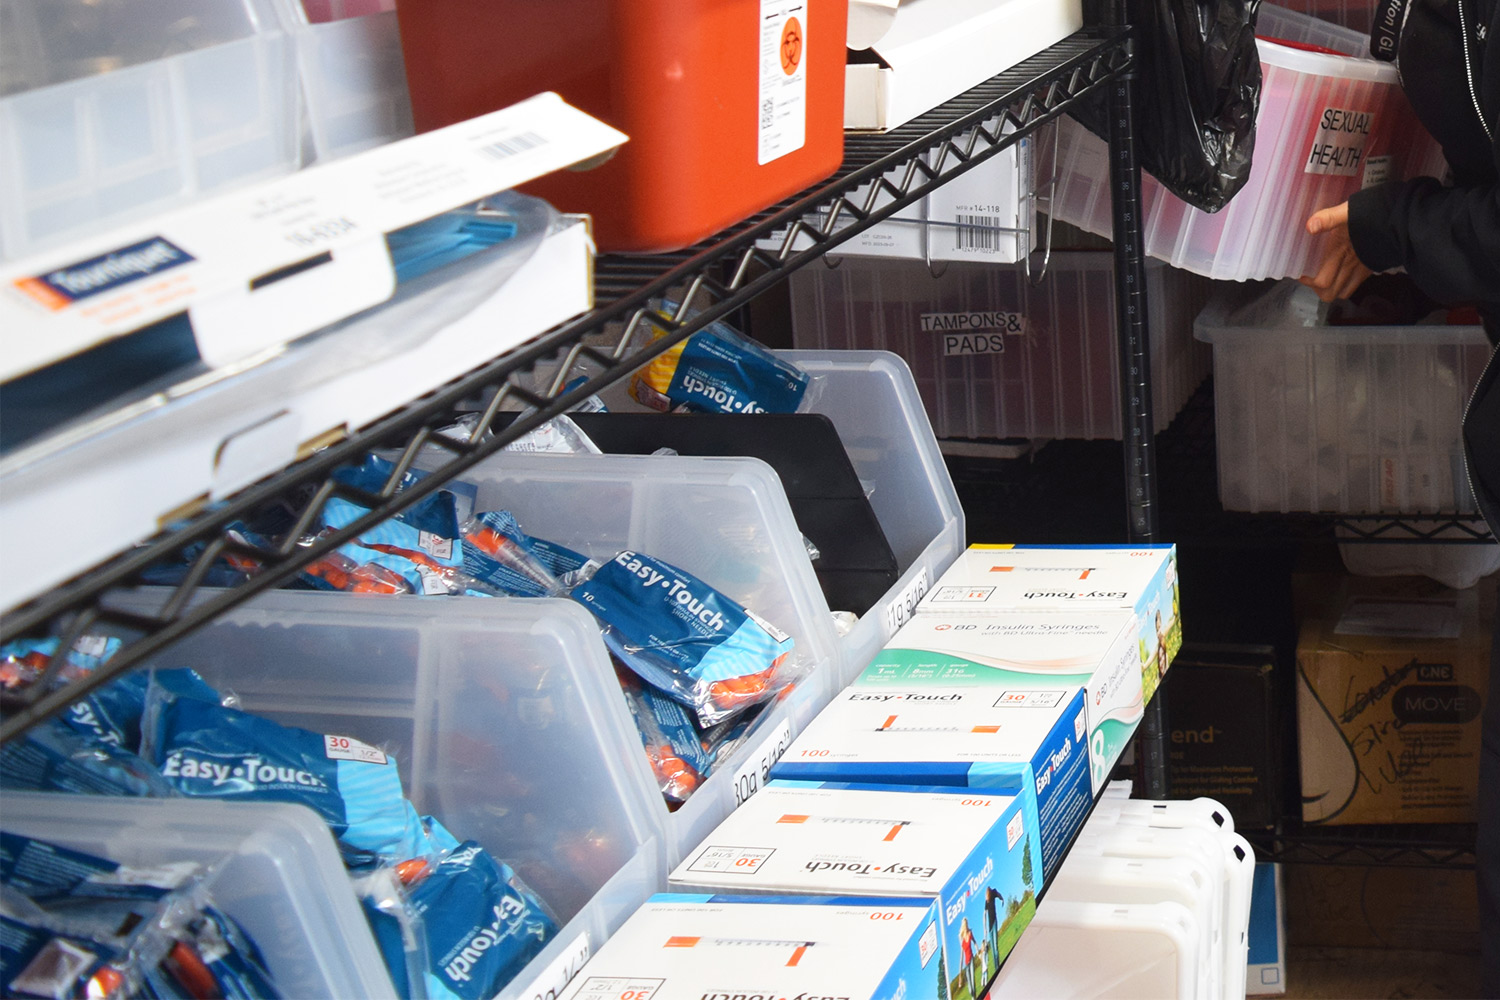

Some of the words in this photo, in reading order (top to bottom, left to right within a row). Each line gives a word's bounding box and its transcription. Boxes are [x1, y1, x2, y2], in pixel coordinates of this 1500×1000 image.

[1320, 108, 1371, 136] SEXUAL
[1309, 143, 1362, 169] HEALTH
[975, 205, 1000, 213] 14-118
[48, 242, 180, 293] Tourniquet
[945, 335, 1004, 353] PADS
[788, 381, 798, 391] 10
[683, 375, 734, 413] Touch
[582, 591, 595, 602] 10
[614, 550, 664, 588] Easy
[667, 579, 724, 632] Touch
[1086, 592, 1128, 600] Easy
[1039, 624, 1100, 632] Syringes
[849, 694, 898, 702] Easy
[1405, 697, 1465, 711] MOVE
[329, 737, 350, 748] 30
[1092, 729, 1105, 785] 8
[164, 753, 230, 787] Easy
[245, 759, 326, 788] Touch
[1035, 767, 1051, 796] Easy
[1051, 737, 1072, 772] Touch
[960, 799, 991, 807] 100
[735, 858, 760, 866] 30
[805, 861, 872, 875] Touch
[885, 864, 937, 878] Easy
[946, 895, 966, 925] Easy
[966, 858, 993, 896] Touch
[870, 912, 904, 921] 100
[443, 922, 498, 985] Touch
